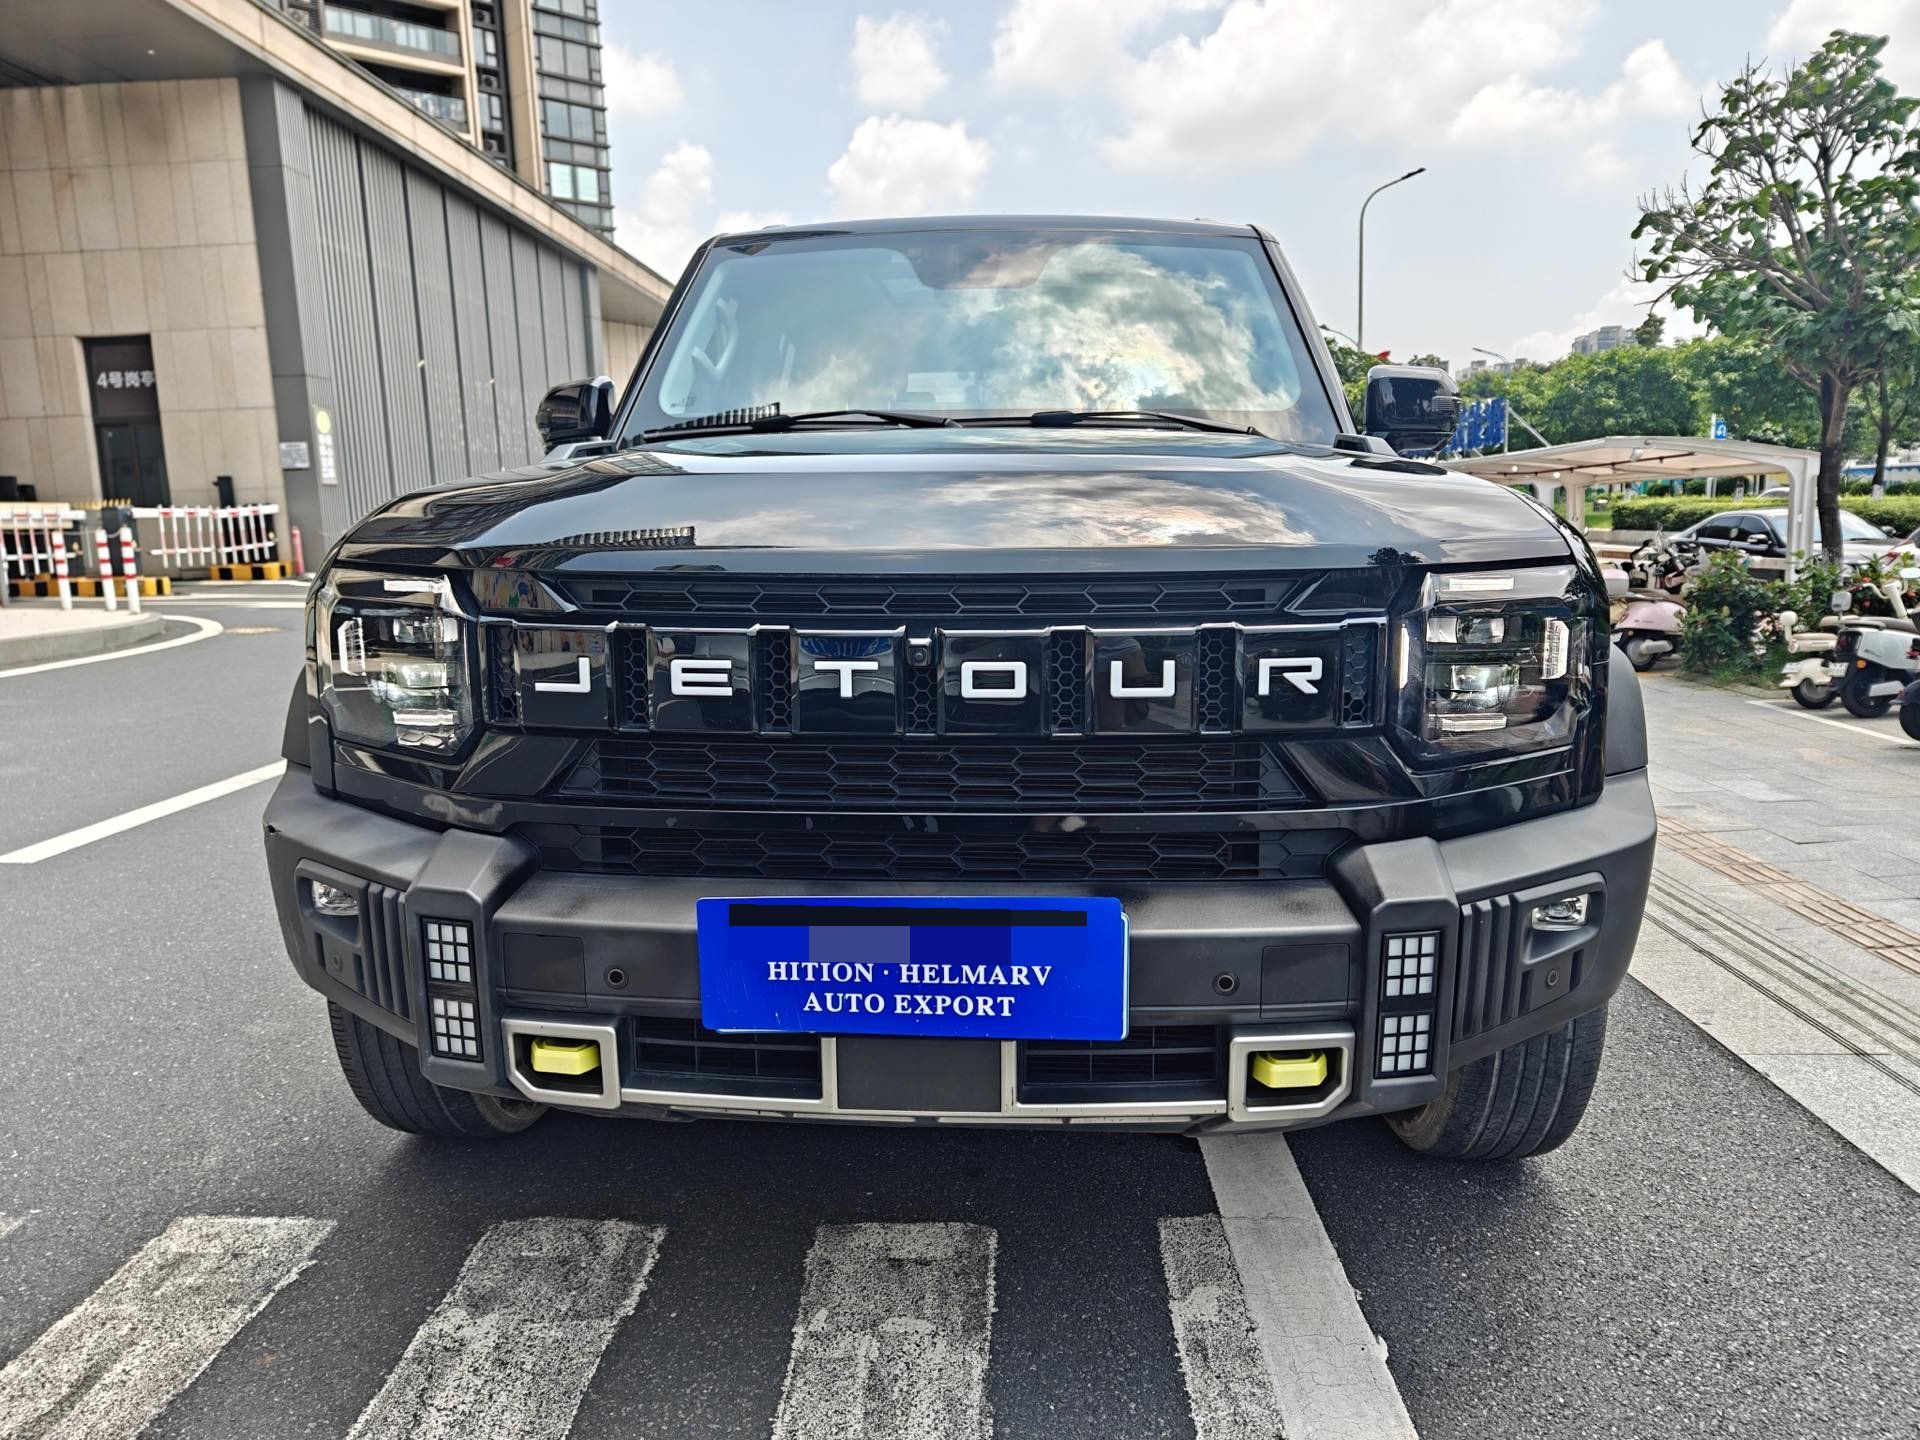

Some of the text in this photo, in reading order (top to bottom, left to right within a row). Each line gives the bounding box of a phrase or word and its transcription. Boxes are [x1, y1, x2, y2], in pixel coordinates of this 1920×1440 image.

[96, 370, 155, 389] 4号岗亭
[534, 655, 1323, 700] JETOUR
[767, 961, 1052, 986] HITION HELMARV
[803, 992, 1015, 1017] AUTO EXPORT
